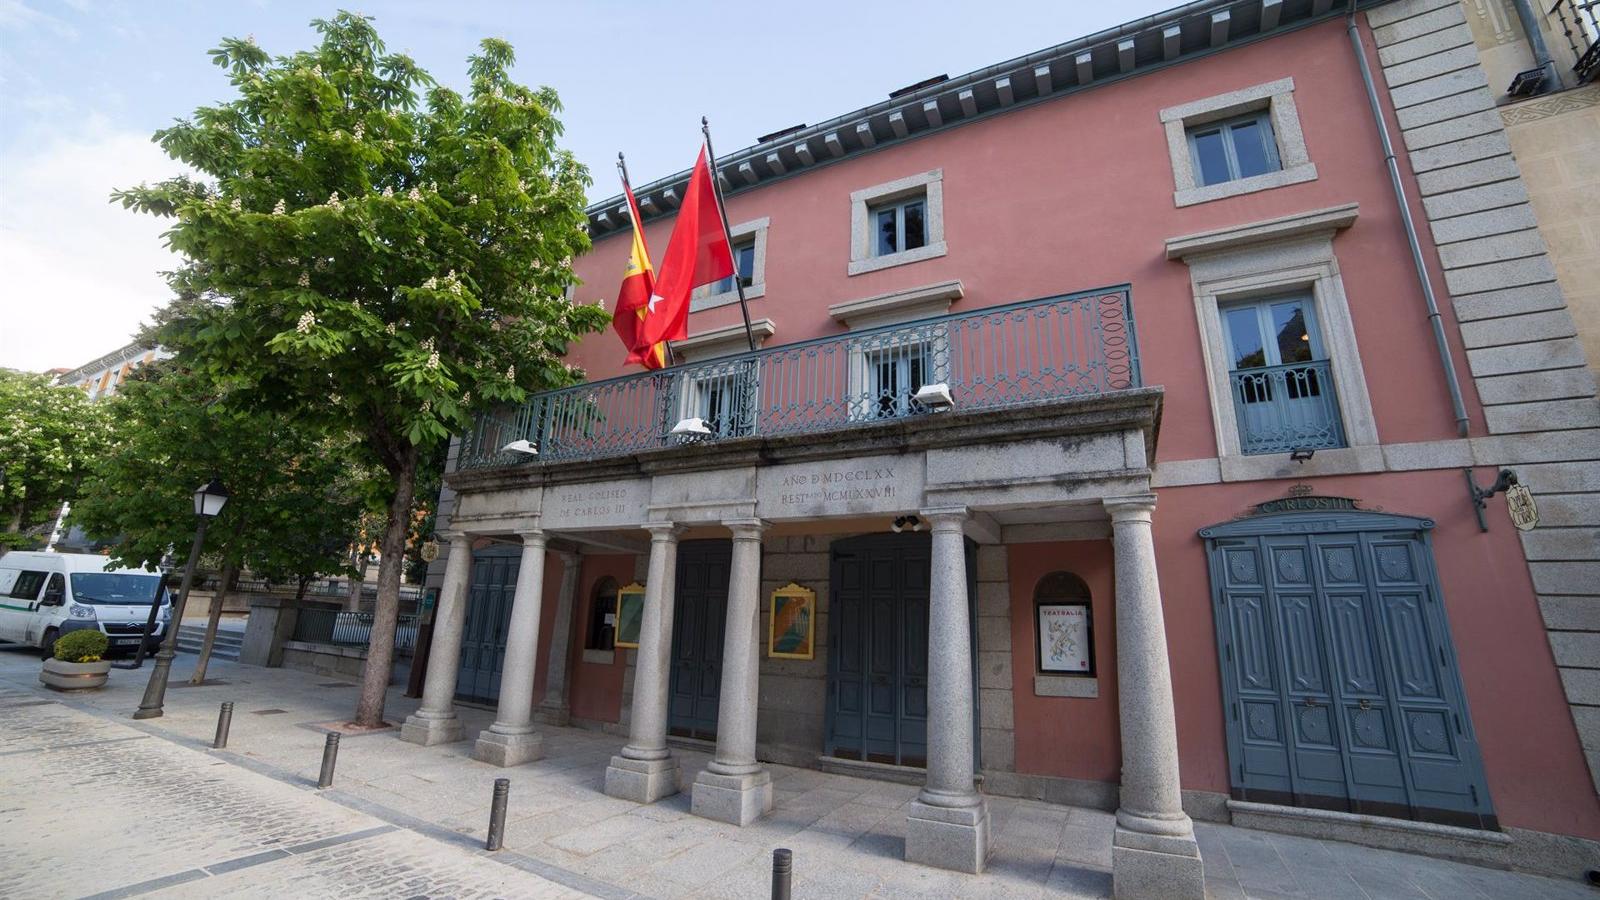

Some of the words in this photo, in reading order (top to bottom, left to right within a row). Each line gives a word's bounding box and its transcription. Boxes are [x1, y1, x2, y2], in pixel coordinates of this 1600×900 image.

[589, 489, 627, 500] COLISEO
[575, 505, 611, 517] CARLOS
[615, 503, 625, 514] III
[1263, 498, 1329, 513] CARLOS
[1333, 498, 1349, 510] III
